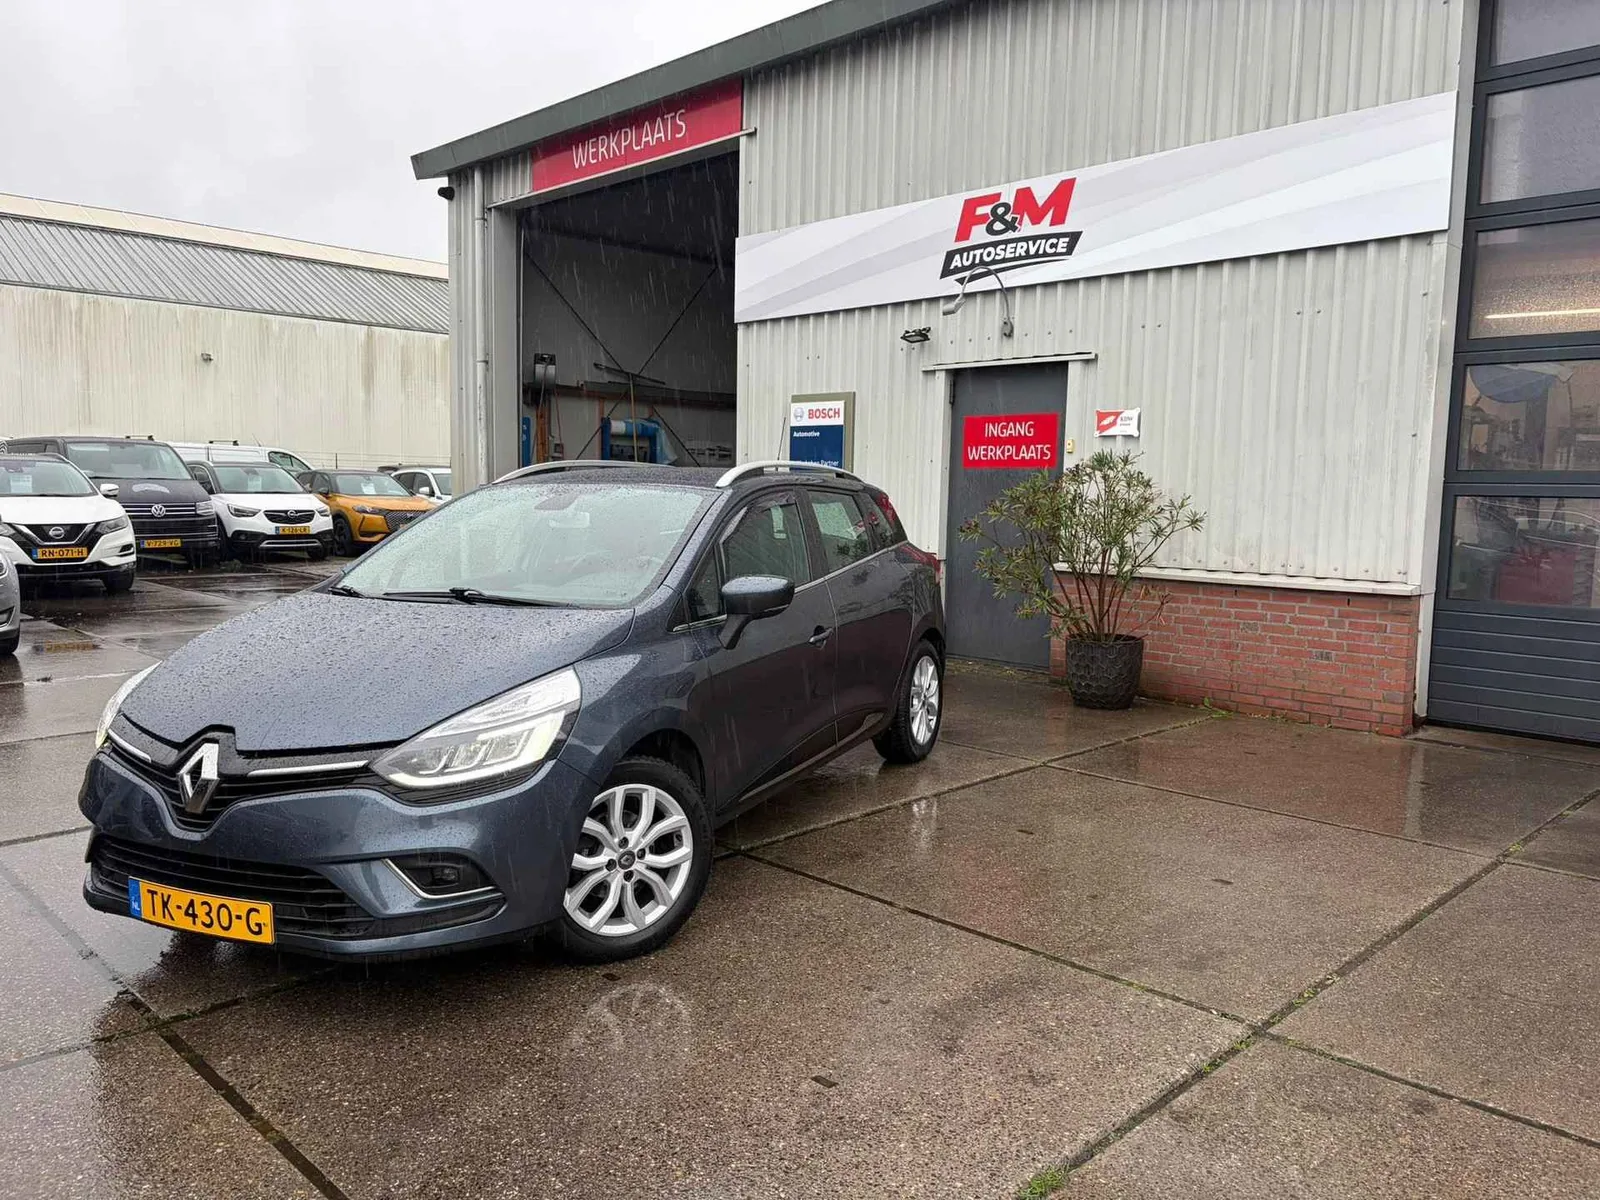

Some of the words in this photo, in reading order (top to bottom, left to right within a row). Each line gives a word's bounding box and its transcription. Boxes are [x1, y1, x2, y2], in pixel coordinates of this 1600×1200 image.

[572, 109, 687, 169] WERKPLAATS
[954, 177, 1077, 243] F&M
[949, 237, 1070, 270] AUTOSERVICE
[807, 407, 841, 420] BOSCH
[793, 430, 820, 438] Automotive
[984, 421, 1035, 438] INGANG
[967, 444, 1052, 461] WERKPLAATS
[40, 548, 84, 558] RN-071-H
[146, 888, 264, 936] TK-430-G
